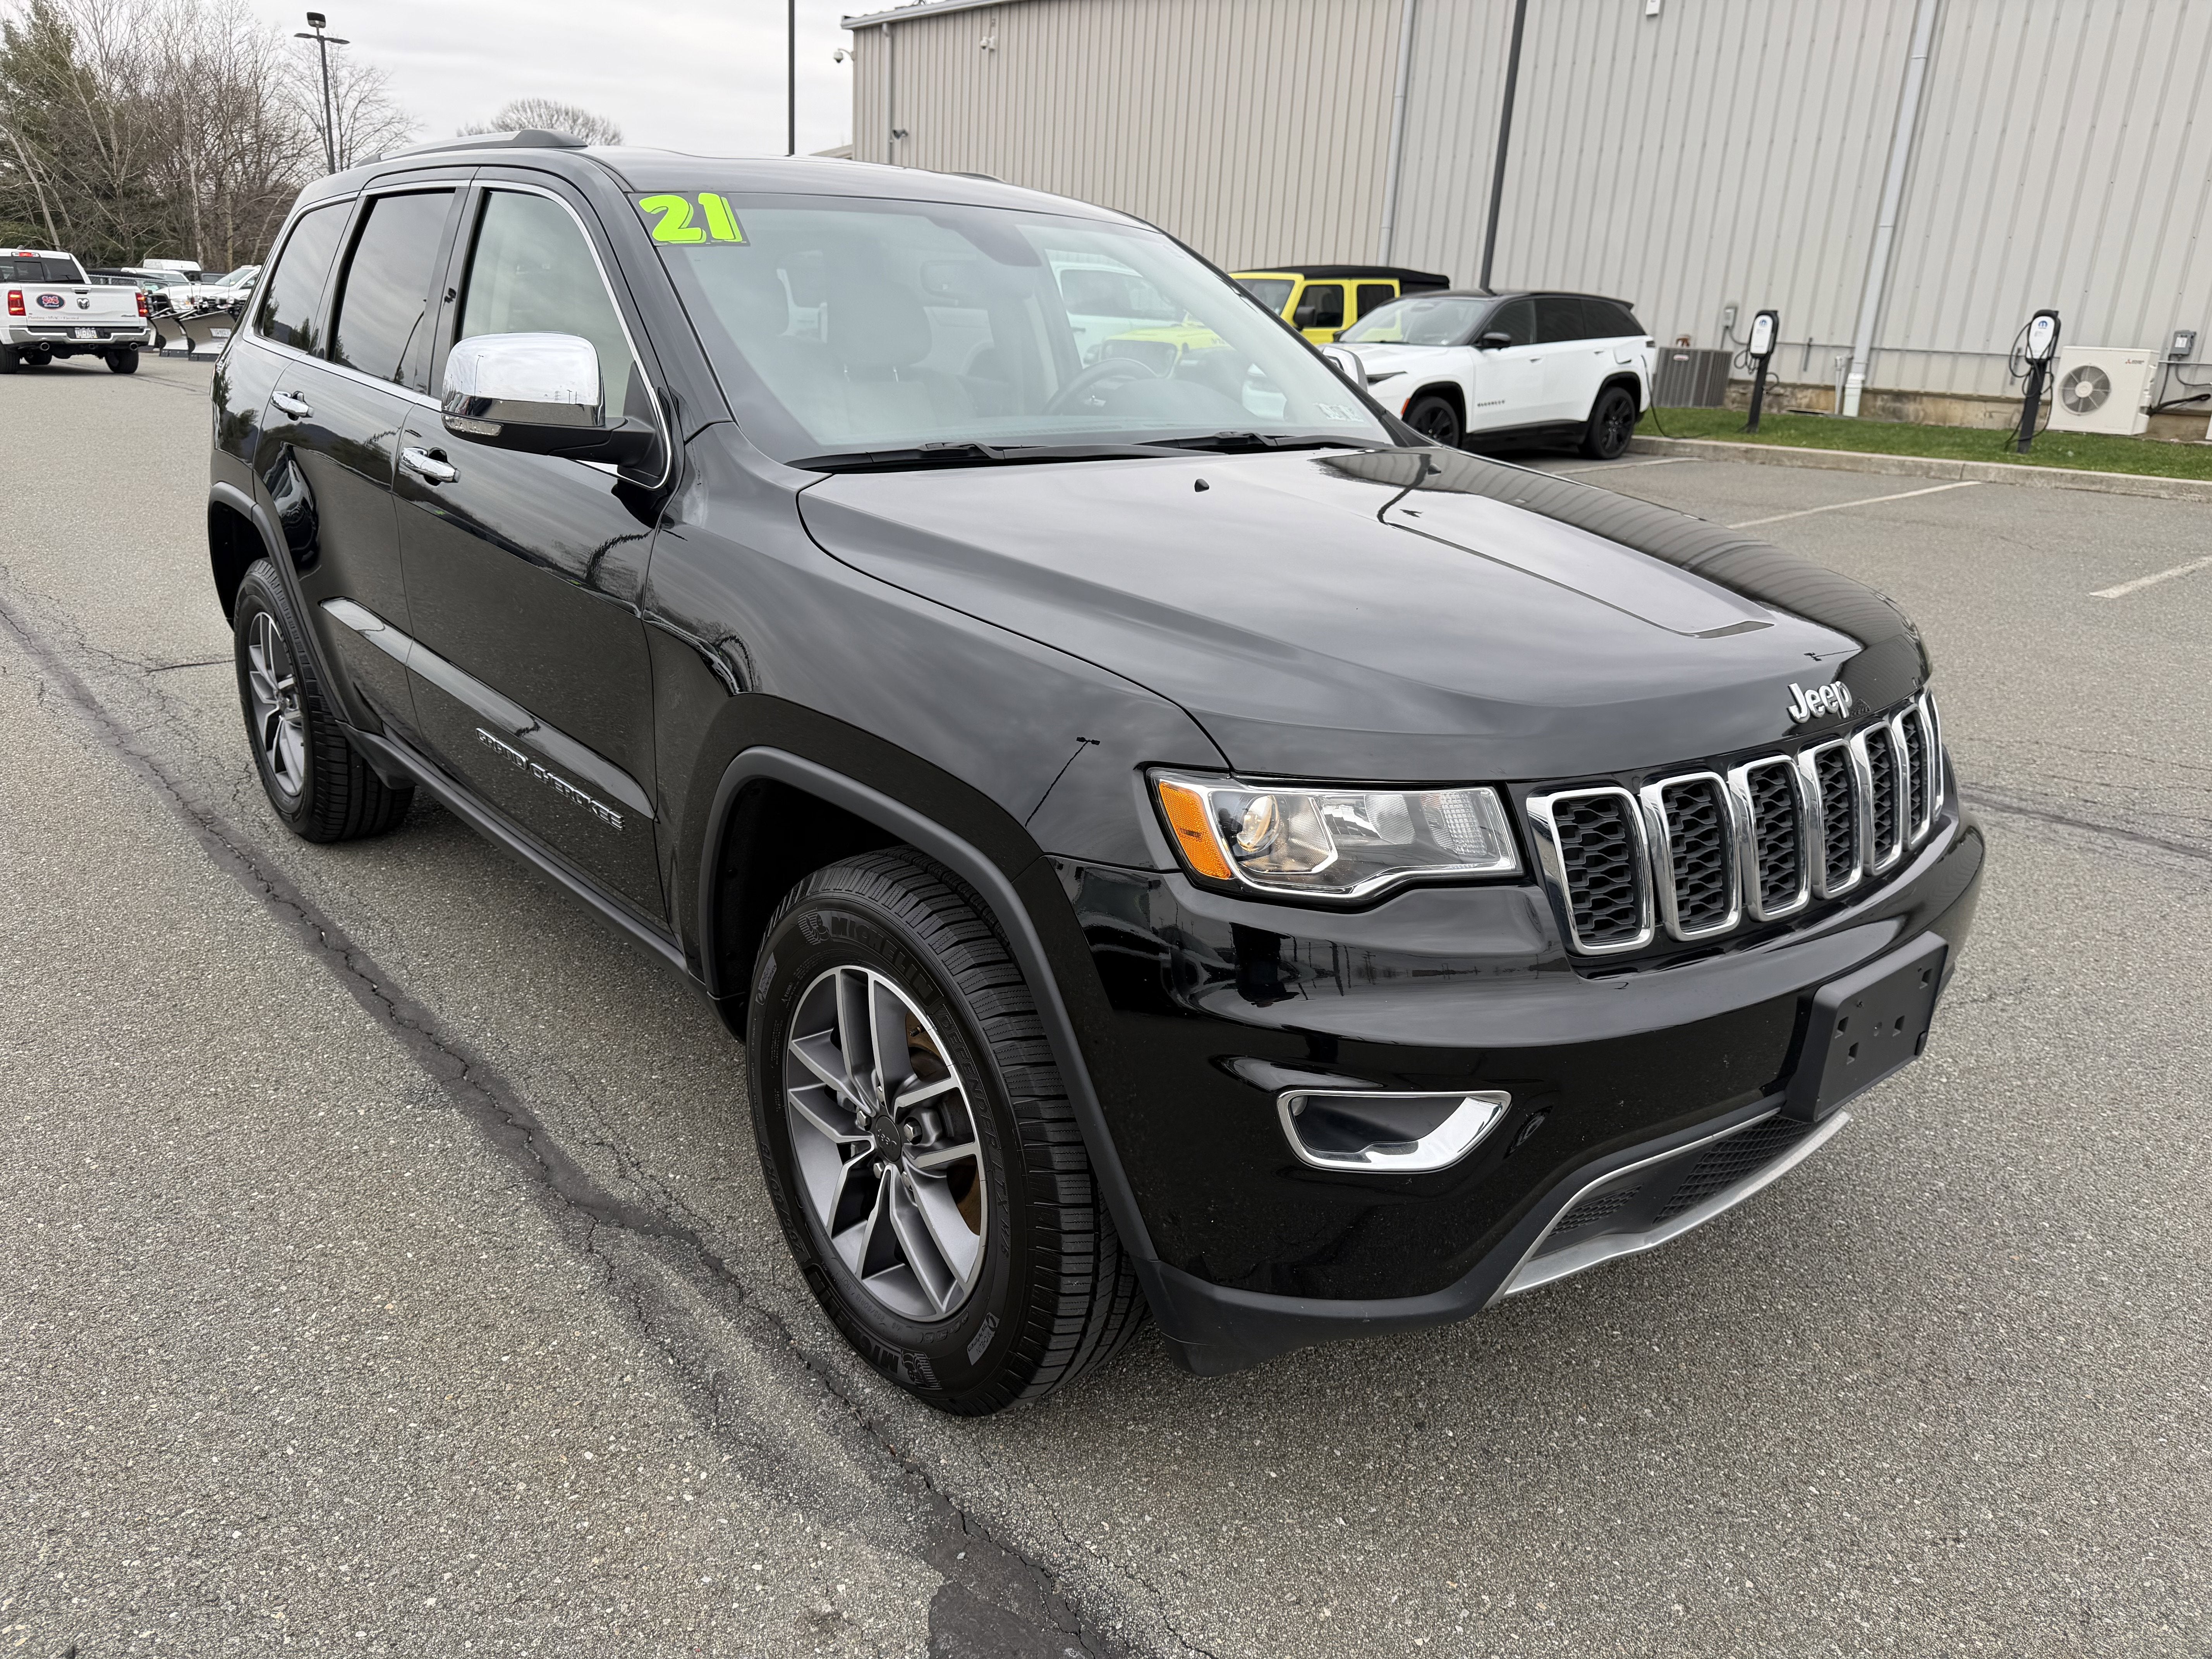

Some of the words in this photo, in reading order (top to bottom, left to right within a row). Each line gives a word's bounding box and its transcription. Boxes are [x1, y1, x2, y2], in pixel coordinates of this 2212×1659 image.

[639, 192, 743, 244] 21
[1786, 680, 1853, 723] Jeep
[475, 727, 528, 770] GRAND
[530, 763, 625, 831] CHEROKEE
[831, 915, 934, 999] MICHELIN
[941, 1013, 1001, 1150] DEFENDER
